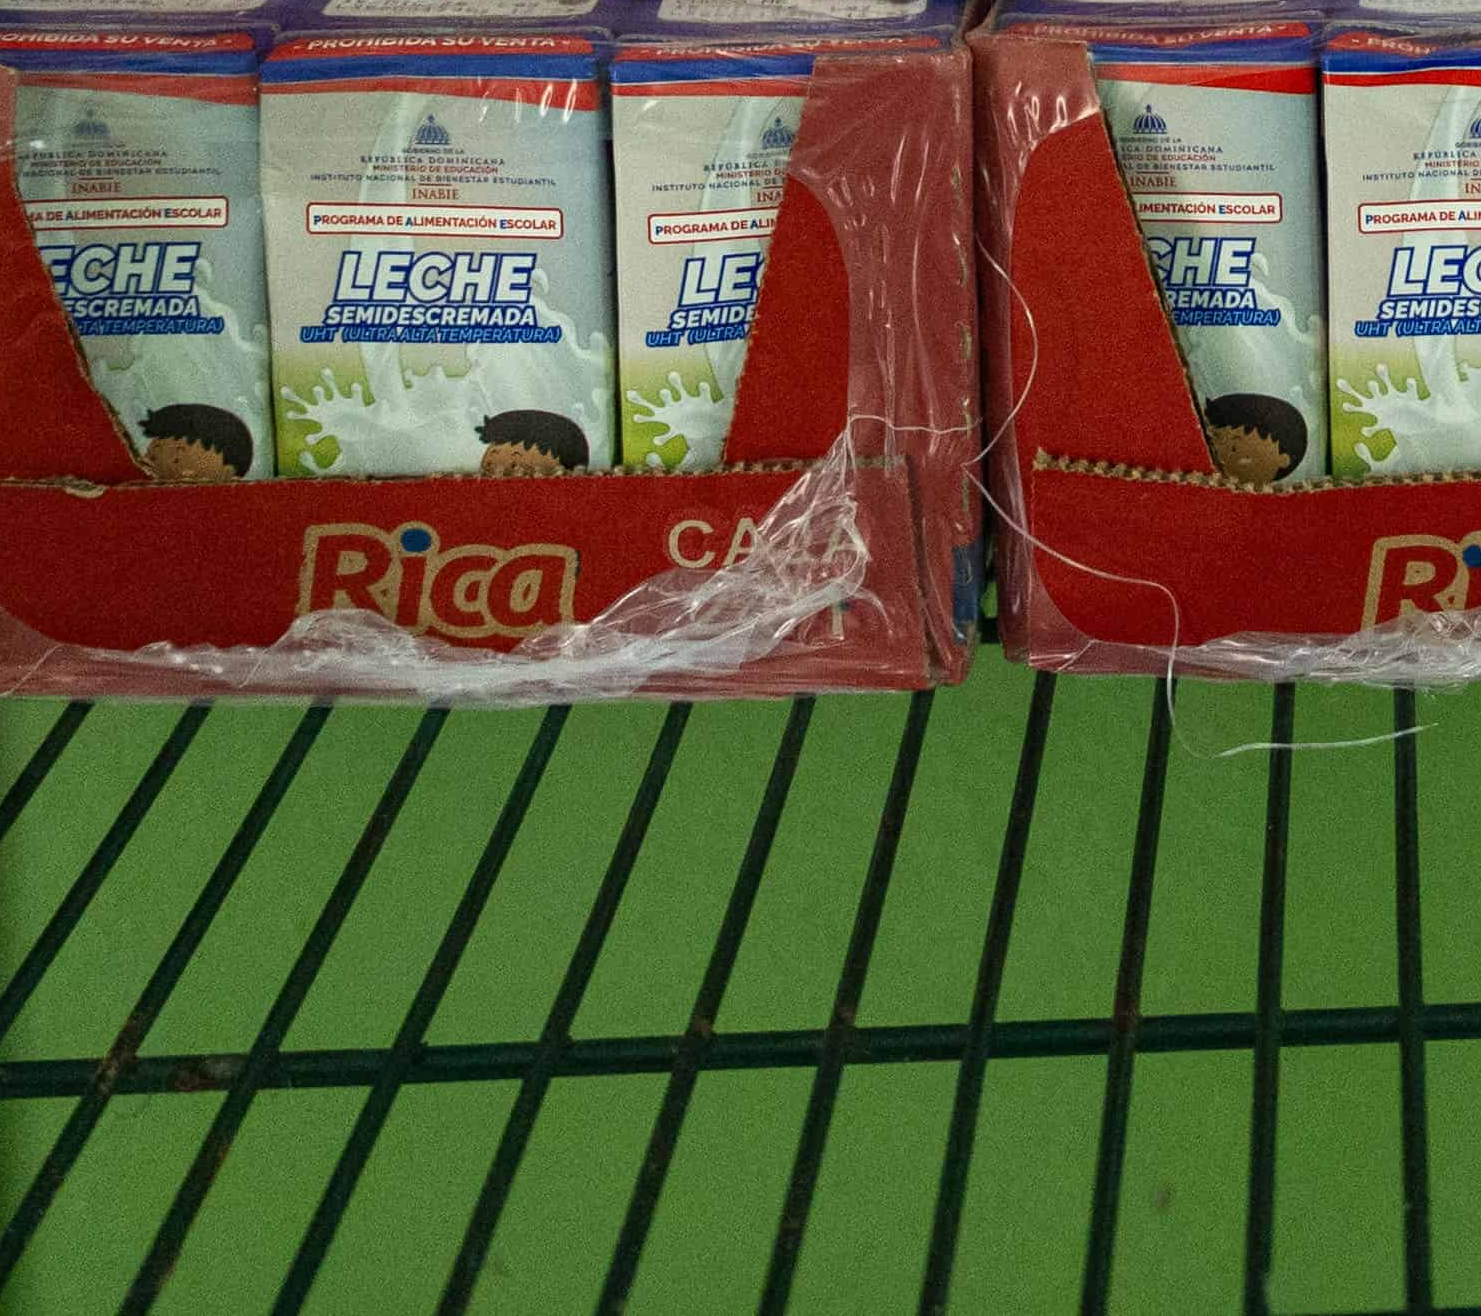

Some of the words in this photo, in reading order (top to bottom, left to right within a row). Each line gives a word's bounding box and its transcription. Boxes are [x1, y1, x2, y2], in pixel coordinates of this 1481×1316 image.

[307, 37, 436, 50] PROHIBIDA
[411, 189, 459, 200] INABIE
[313, 214, 384, 226] PROGRAMA
[387, 215, 403, 226] DE
[405, 214, 498, 229] ALIMENTACIÓN
[499, 219, 556, 230] ESCOLAR
[1365, 211, 1437, 225] PROGRAMA
[1439, 211, 1456, 221] DE
[334, 249, 536, 306] LECHE
[324, 303, 537, 329] SEMIDESCREMADA
[1355, 321, 1388, 337] UHT
[1396, 319, 1456, 336] (ULTRA
[295, 523, 579, 640] Rica
